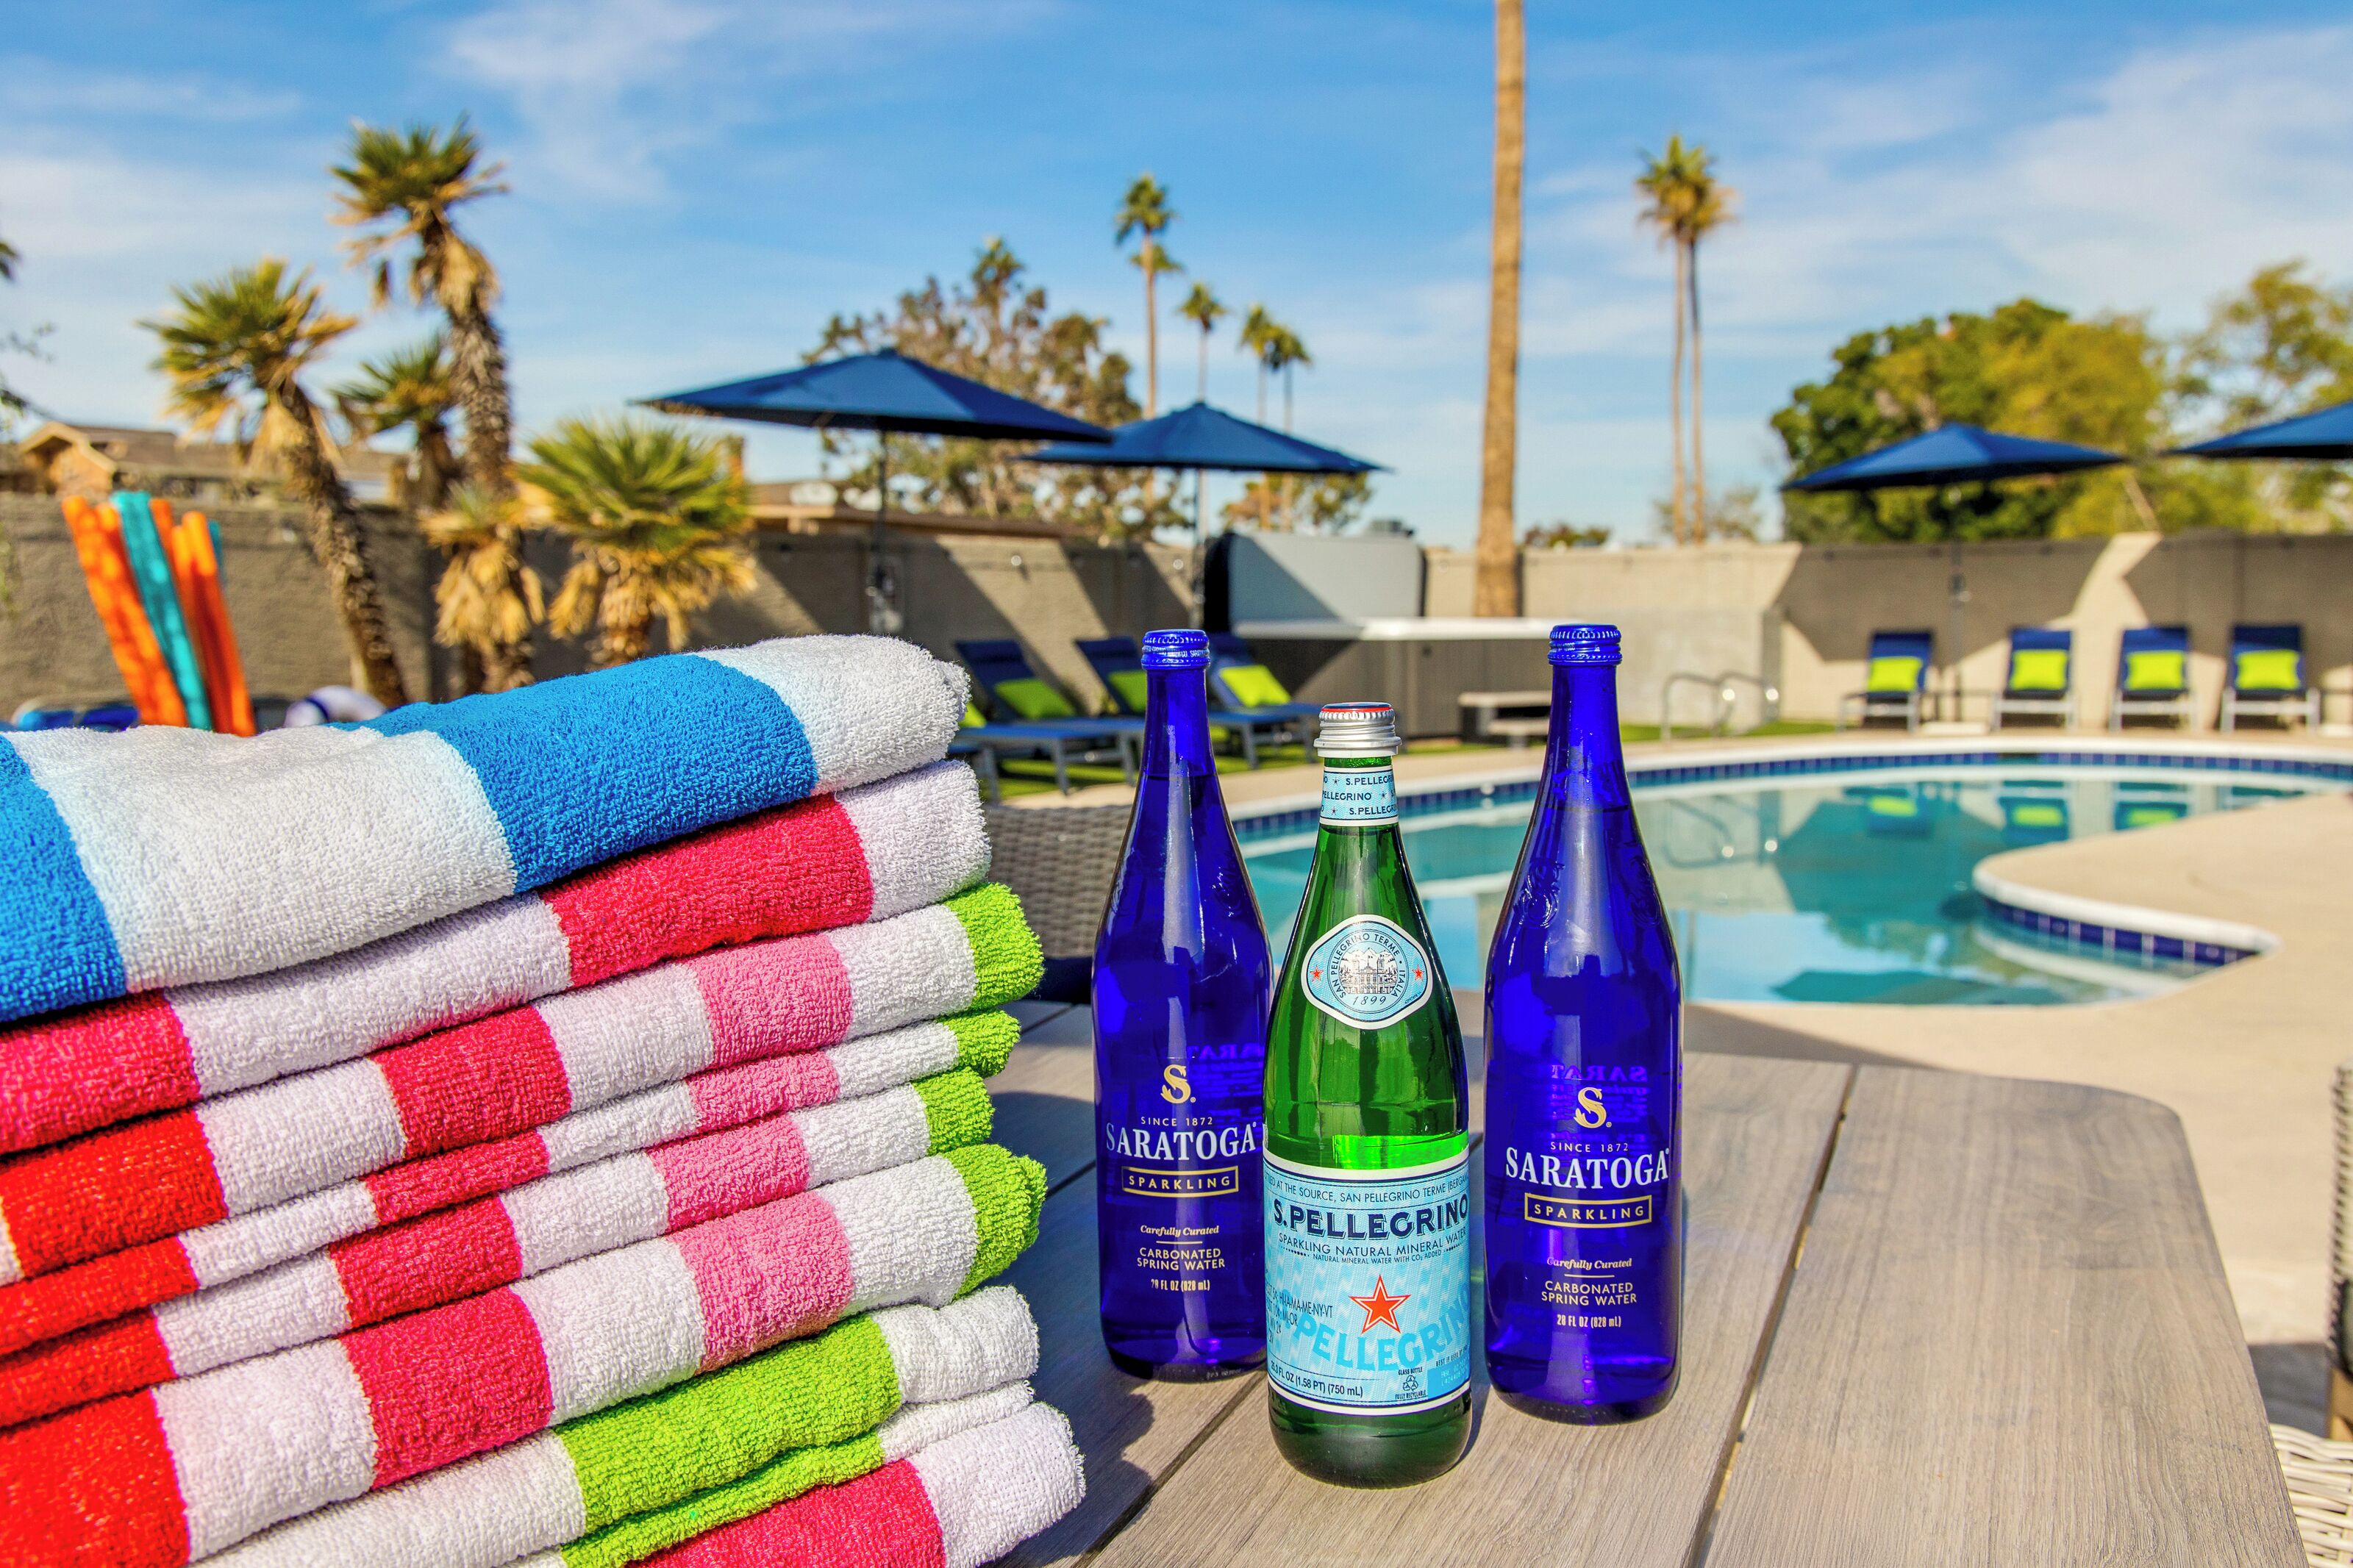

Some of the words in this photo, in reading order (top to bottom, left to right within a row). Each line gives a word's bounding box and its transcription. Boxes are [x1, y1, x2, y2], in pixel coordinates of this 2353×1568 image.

[1374, 934, 1400, 956] TERME
[1331, 933, 1370, 975] PELLEGRINO
[1332, 981, 1346, 998] SAN
[1391, 970, 1406, 998] ITALIA
[1352, 996, 1386, 1006] 1899
[1141, 1117, 1176, 1126] SINCE
[1185, 1117, 1213, 1126] 1872
[1106, 1123, 1256, 1161] SARATOGA
[1550, 1142, 1590, 1153] SINCE
[1601, 1143, 1629, 1153] 1872
[1506, 1147, 1668, 1189] SARATOGA
[1129, 1175, 1230, 1189] SPARKLING
[1285, 1183, 1296, 1195] THE
[1299, 1187, 1337, 1203] SOURCE,
[1340, 1192, 1361, 1203] SAN
[1365, 1189, 1420, 1203] PELLEGRINO
[1423, 1183, 1446, 1197] TERME
[1274, 1193, 1468, 1240] S.PELLEGRINO
[1534, 1204, 1644, 1220] SPARKLING
[1140, 1225, 1181, 1237] Carefully
[1182, 1225, 1220, 1236] Curated
[1279, 1233, 1331, 1254] SPARKLING
[1335, 1246, 1391, 1256] NATURAL
[1396, 1238, 1443, 1255] MINERAL
[1446, 1226, 1466, 1244] WATER
[1140, 1247, 1221, 1259] CARBONATED
[1313, 1253, 1339, 1263] NATURAL
[1424, 1250, 1441, 1259] ADDED
[1137, 1258, 1179, 1270] SPRING
[1184, 1259, 1225, 1270] WATER
[1547, 1257, 1592, 1270] Carefully
[1594, 1258, 1632, 1269] Curated
[1160, 1280, 1168, 1290] FL
[1170, 1280, 1179, 1291] OZ
[1545, 1281, 1633, 1294] CARBONATED
[1541, 1292, 1589, 1306] SPRING
[1595, 1293, 1637, 1306] WATER
[1557, 1314, 1565, 1325] 28
[1568, 1315, 1577, 1327] FL
[1579, 1317, 1588, 1328] OZ
[1590, 1317, 1607, 1328] (828
[1609, 1316, 1621, 1328] mL)
[1279, 1368, 1285, 1378] FL
[1286, 1372, 1294, 1383] OZ
[1296, 1375, 1311, 1389] (1.58
[1313, 1381, 1325, 1394] PT)
[1328, 1383, 1345, 1395] (750
[1347, 1386, 1363, 1398] mL)
